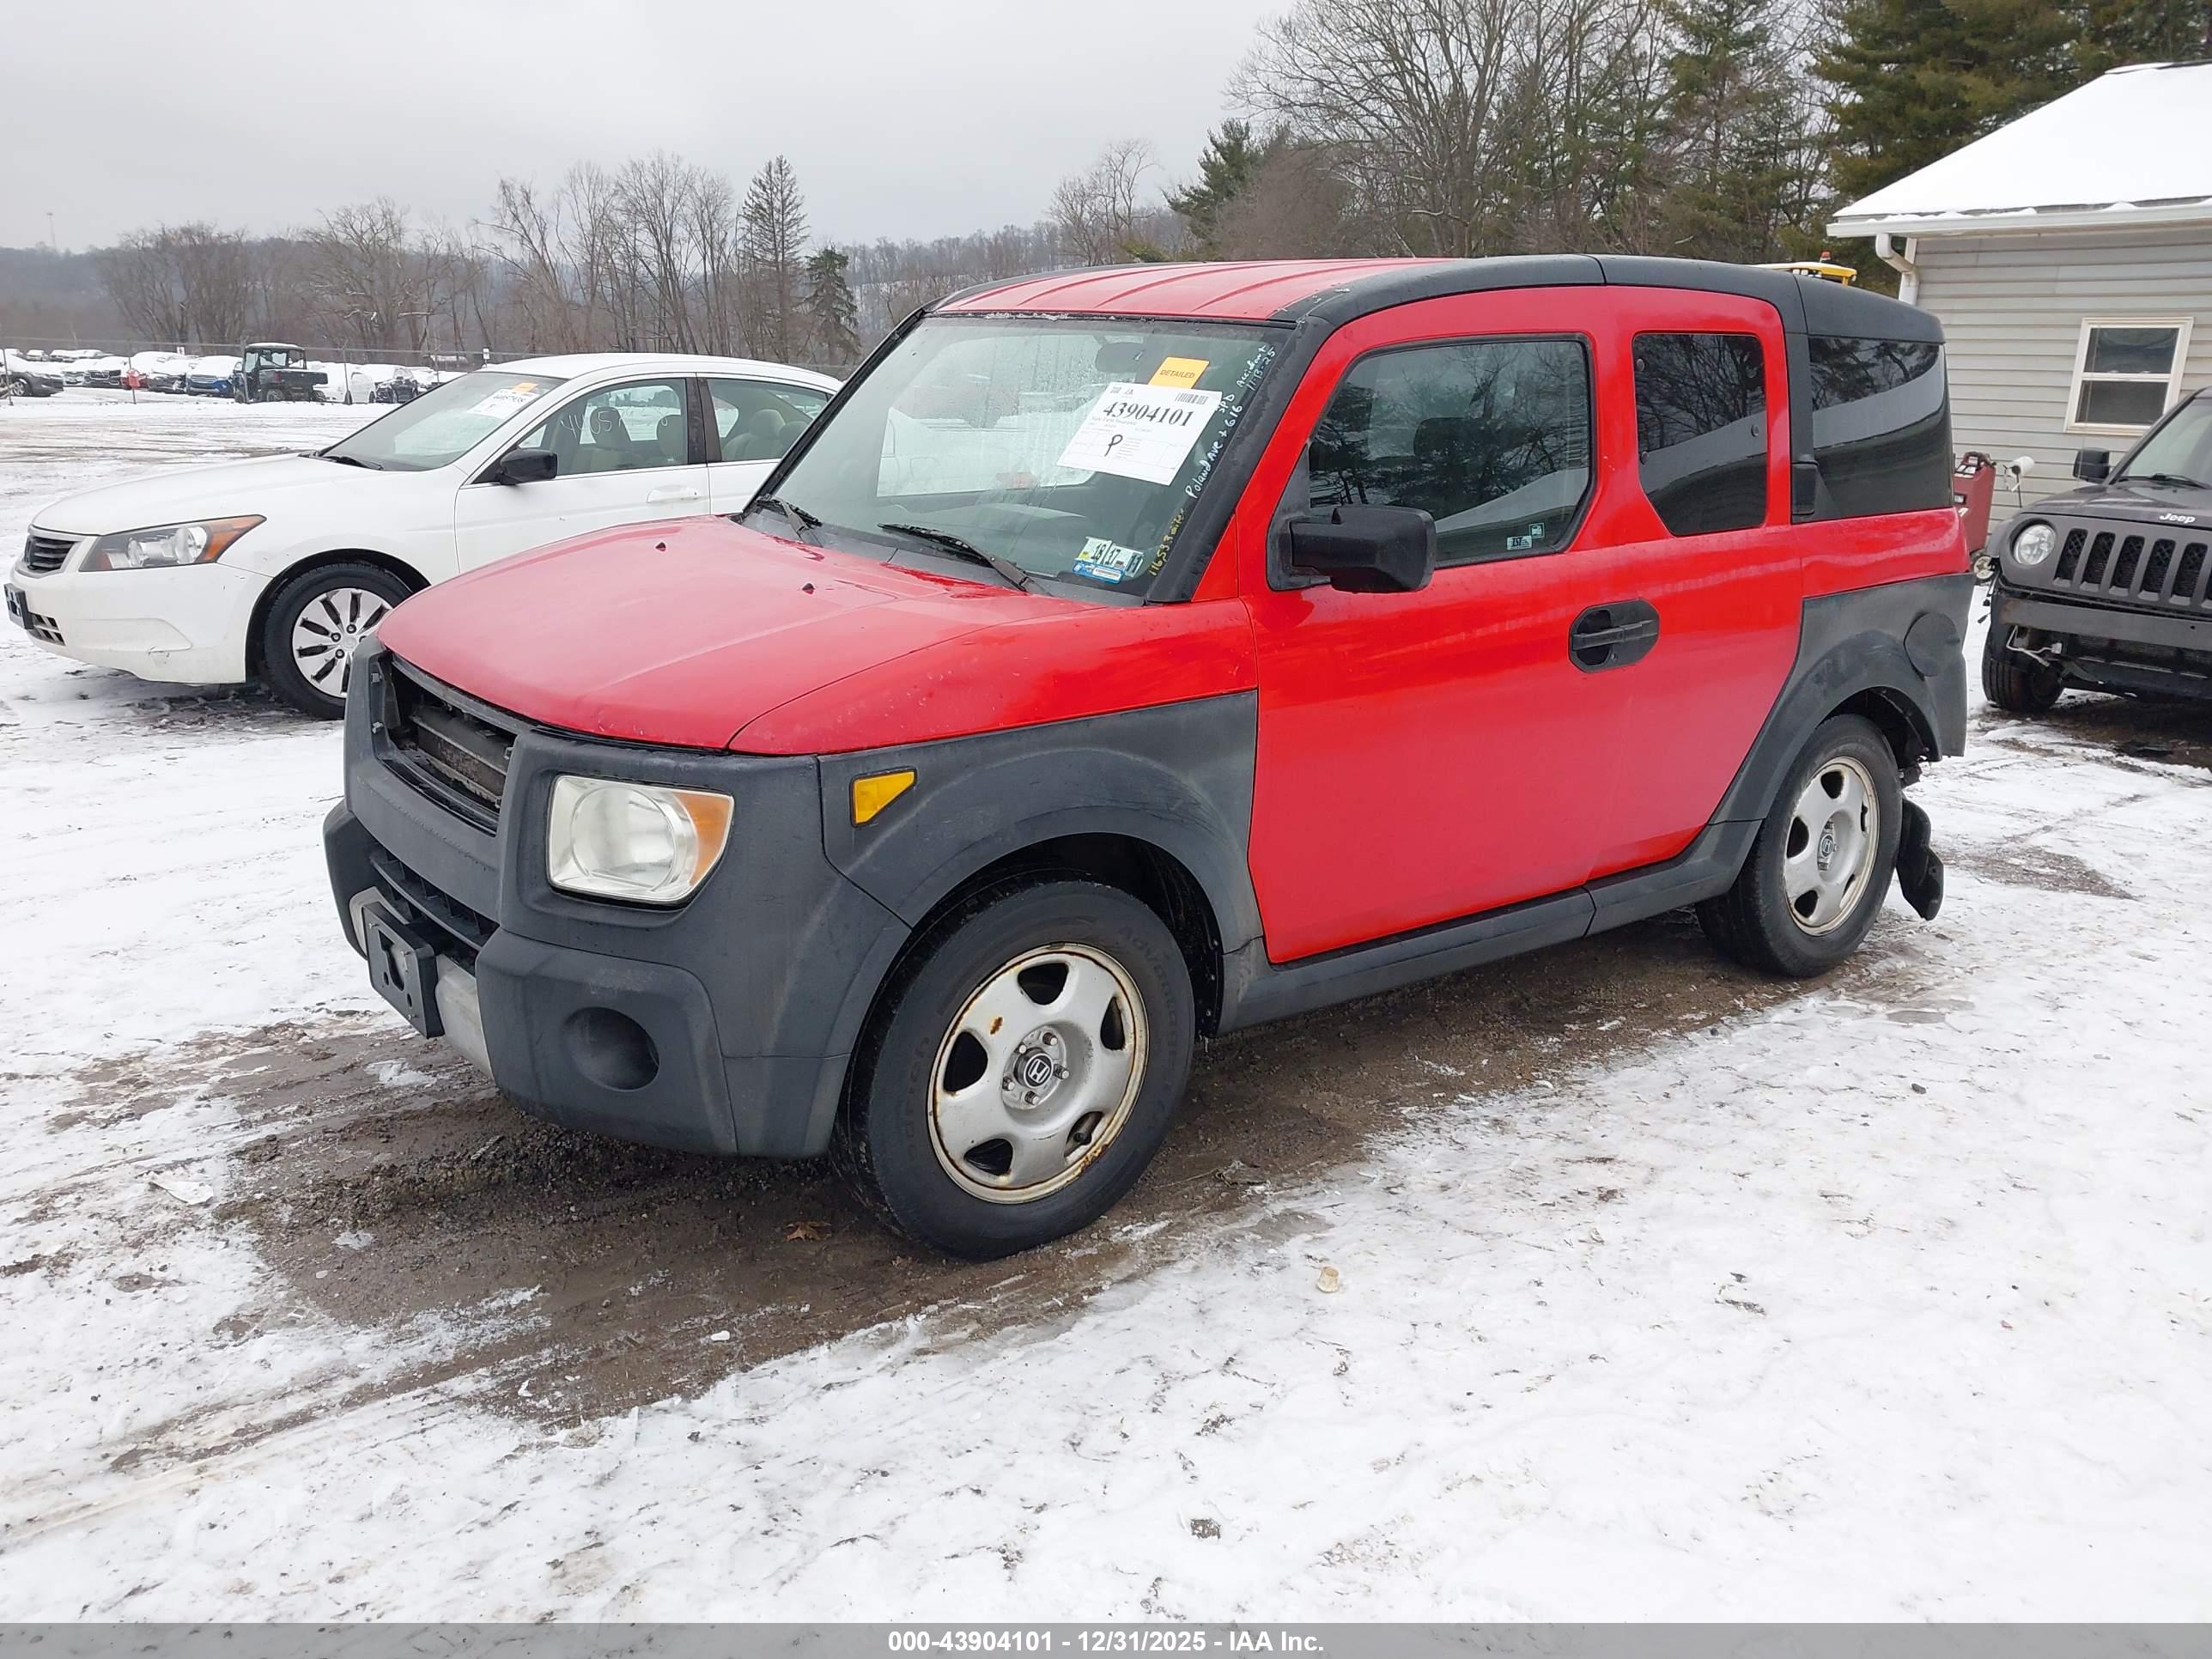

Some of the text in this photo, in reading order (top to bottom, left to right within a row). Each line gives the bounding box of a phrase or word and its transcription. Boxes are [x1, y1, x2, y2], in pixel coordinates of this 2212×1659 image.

[1160, 369, 1195, 380] DETAILED
[1103, 401, 1194, 427] 43904101
[1104, 434, 1123, 457] P
[1185, 459, 1212, 499] Poland
[1225, 405, 1243, 427] 616
[2159, 513, 2196, 524] Jeep
